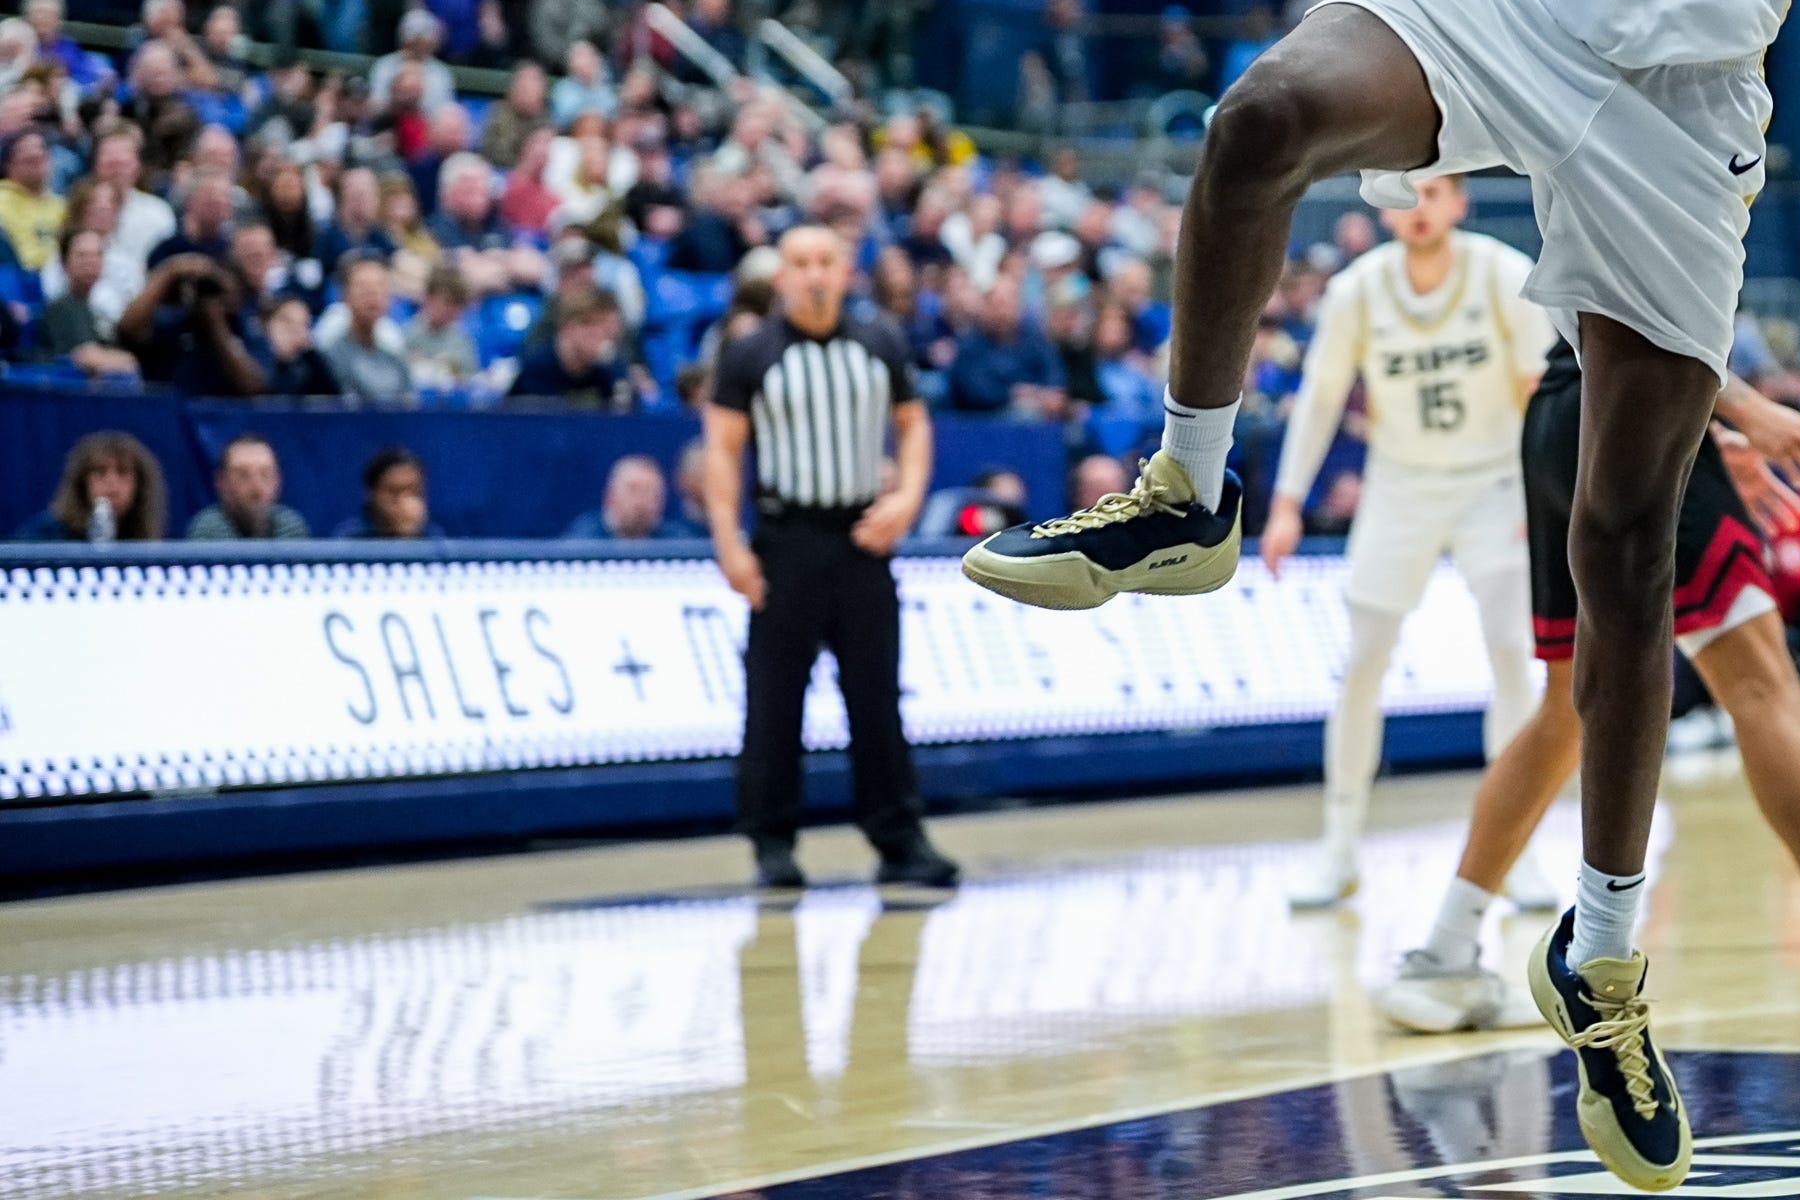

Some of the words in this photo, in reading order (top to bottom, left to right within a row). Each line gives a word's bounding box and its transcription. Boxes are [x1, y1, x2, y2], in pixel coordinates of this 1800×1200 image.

[1383, 343, 1488, 376] ZIPS
[1420, 383, 1467, 432] 15
[321, 606, 575, 725] SALES
